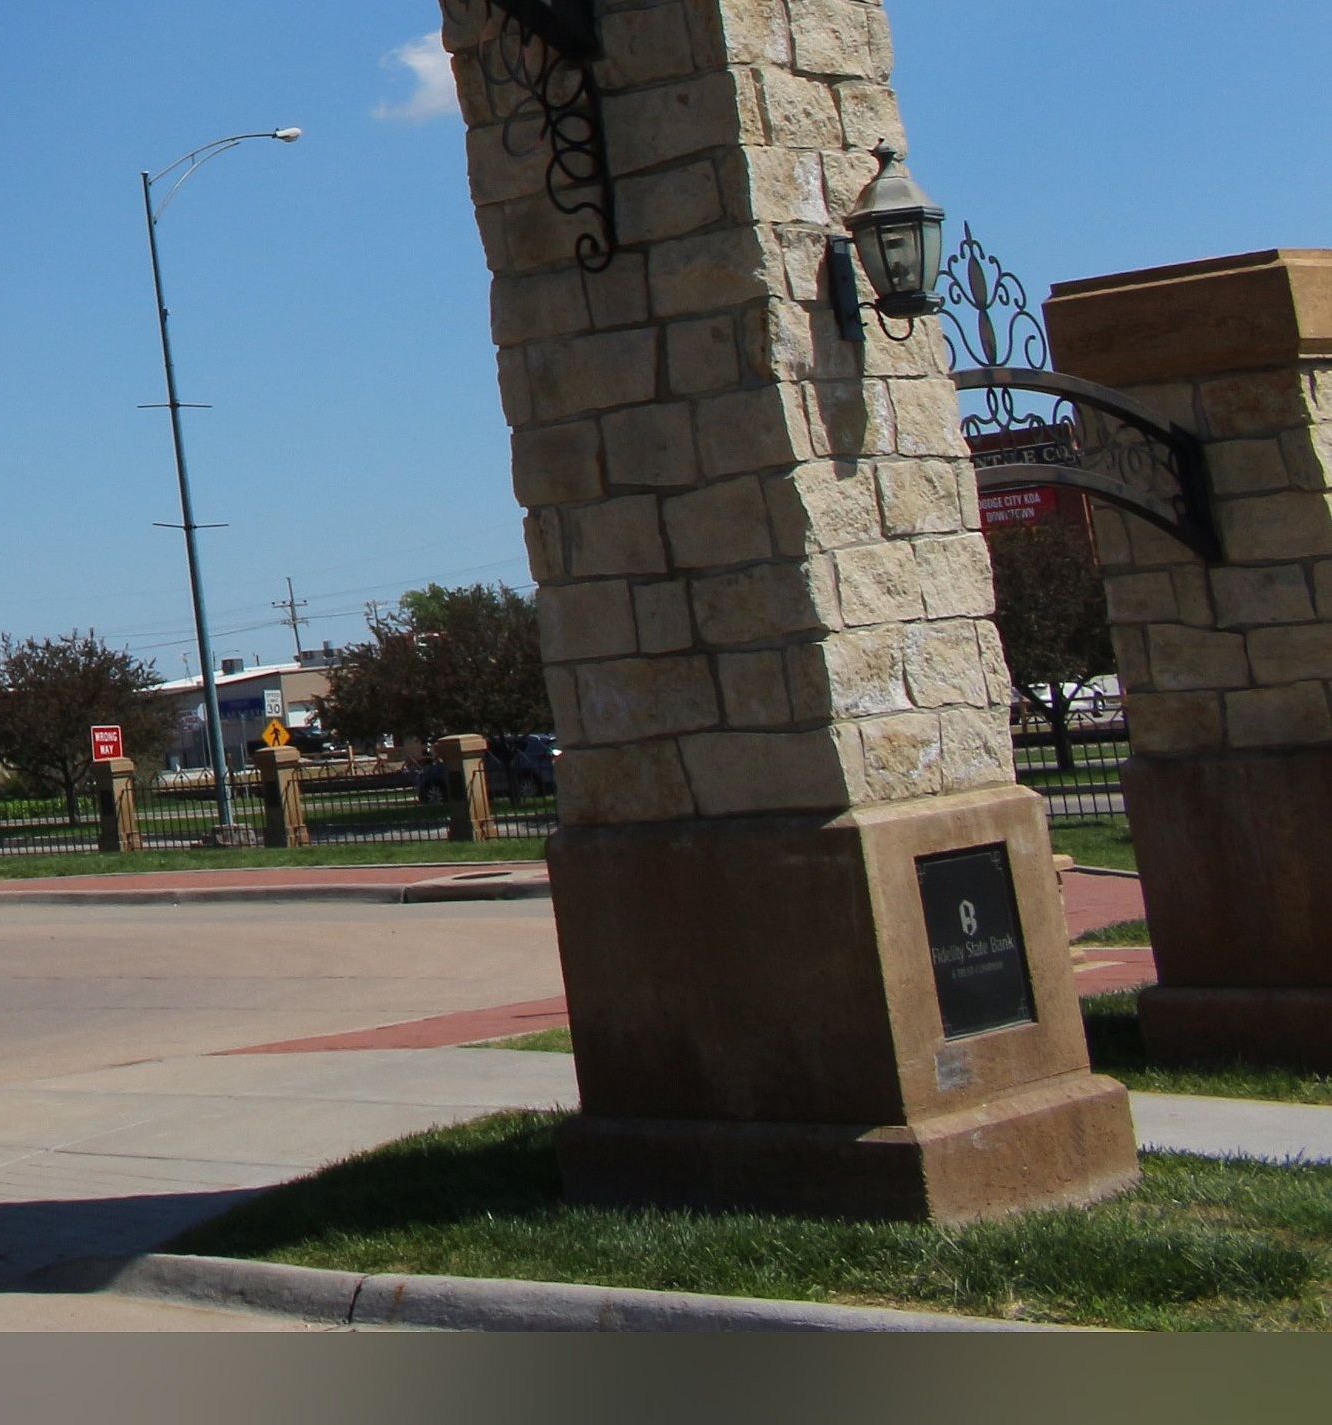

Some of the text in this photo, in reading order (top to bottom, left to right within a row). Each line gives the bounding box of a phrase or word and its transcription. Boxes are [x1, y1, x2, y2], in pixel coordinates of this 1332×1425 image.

[1004, 494, 1022, 507] CITY
[267, 703, 280, 714] 30
[94, 731, 118, 742] WRONG
[99, 744, 114, 755] WAY
[965, 940, 989, 958] State
[990, 933, 1015, 953] Bank
